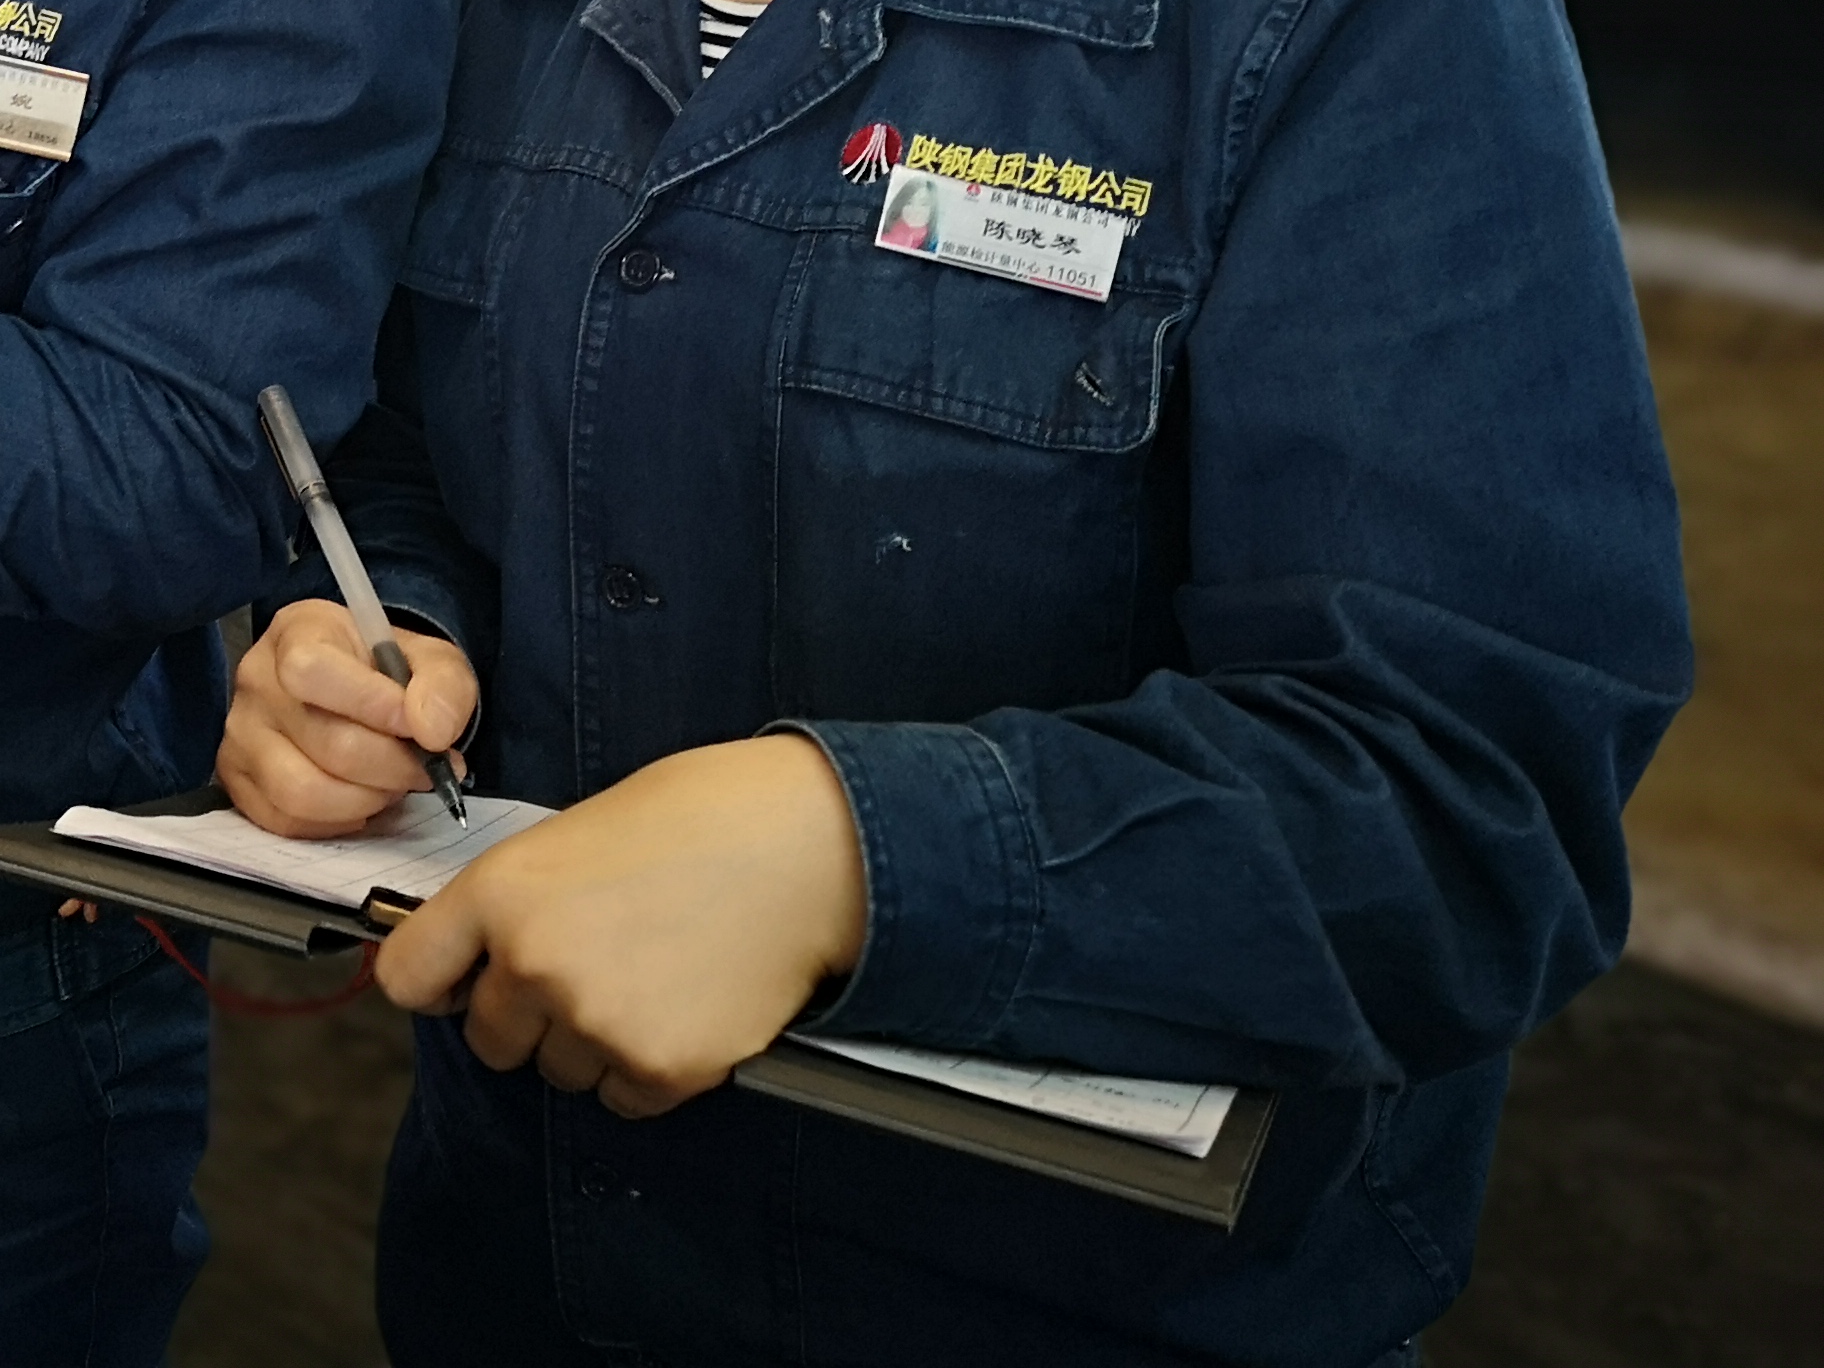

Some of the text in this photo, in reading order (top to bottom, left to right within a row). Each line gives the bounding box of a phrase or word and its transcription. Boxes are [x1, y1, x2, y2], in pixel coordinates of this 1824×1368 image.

[906, 134, 1153, 217] 陕钢集团龙钢公司
[982, 218, 1081, 256] 陈晓琴
[1047, 265, 1097, 288] 11051
